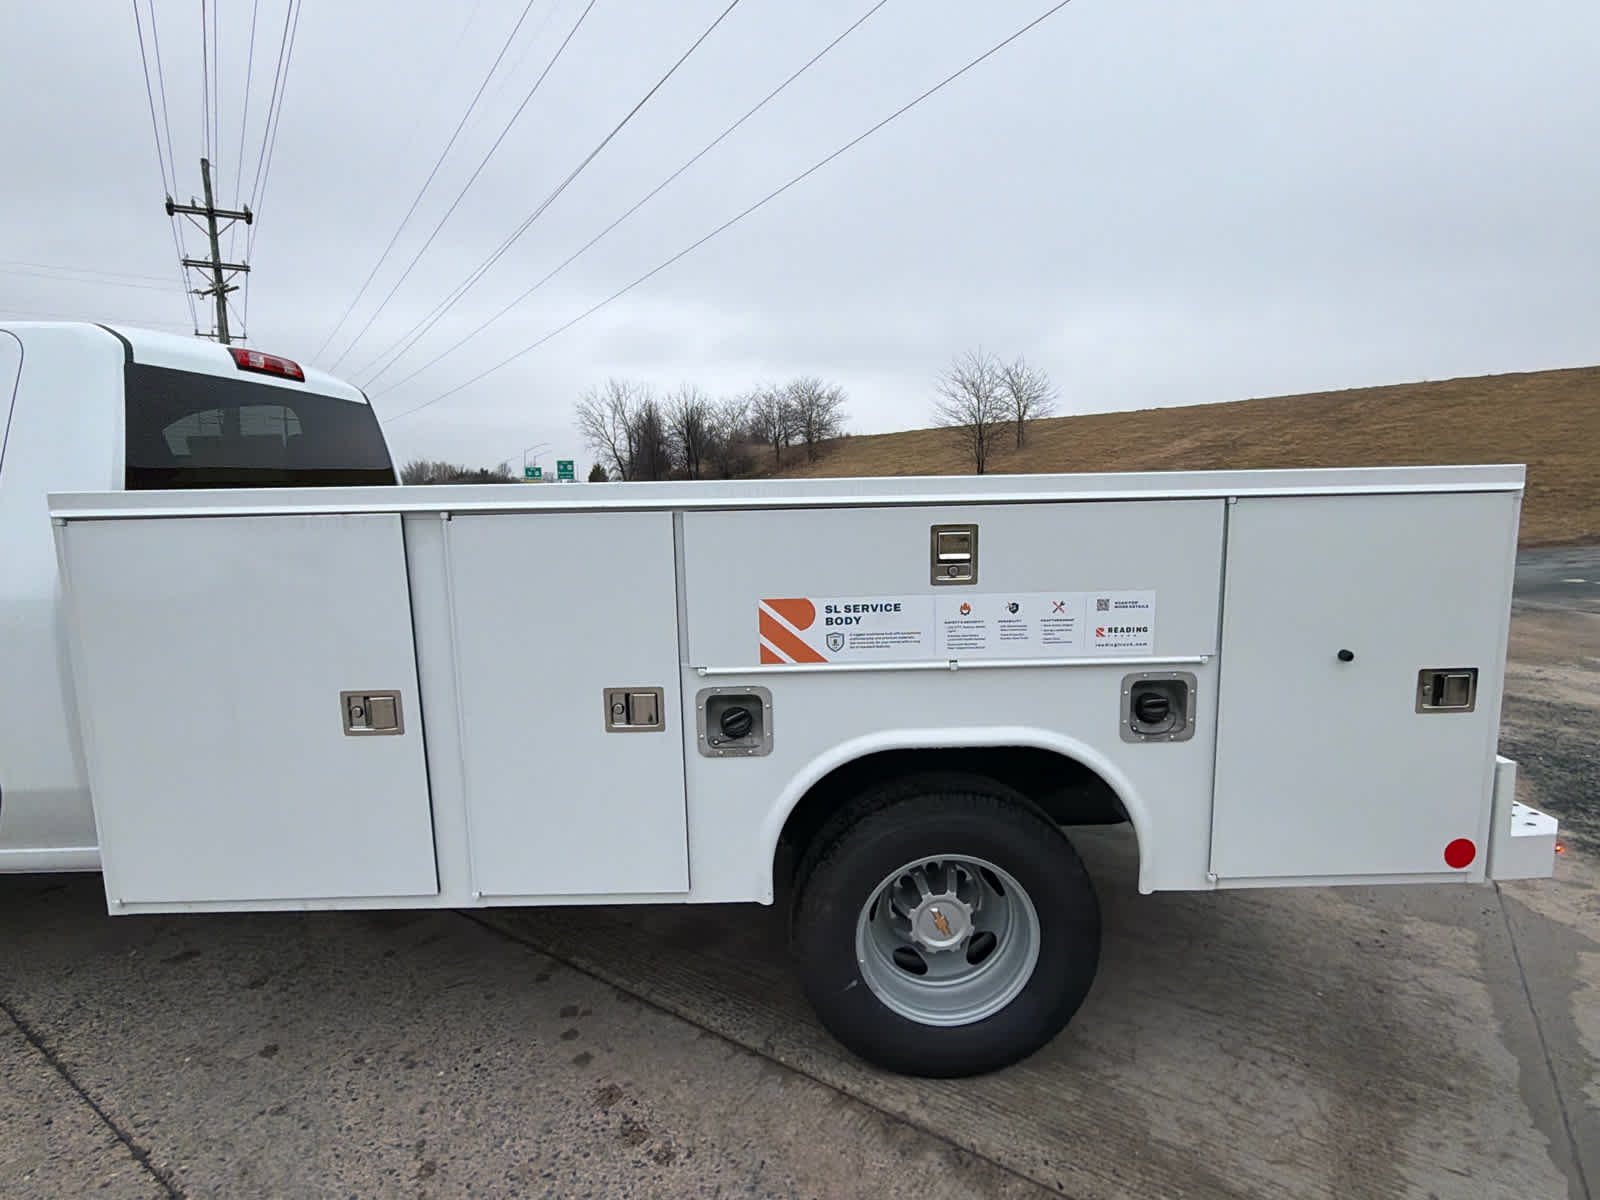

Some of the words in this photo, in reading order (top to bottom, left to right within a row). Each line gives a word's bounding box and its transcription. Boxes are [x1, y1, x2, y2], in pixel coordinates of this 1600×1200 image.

[825, 604, 841, 614] SL
[844, 603, 902, 613] SERVICE
[825, 616, 862, 626] BODY
